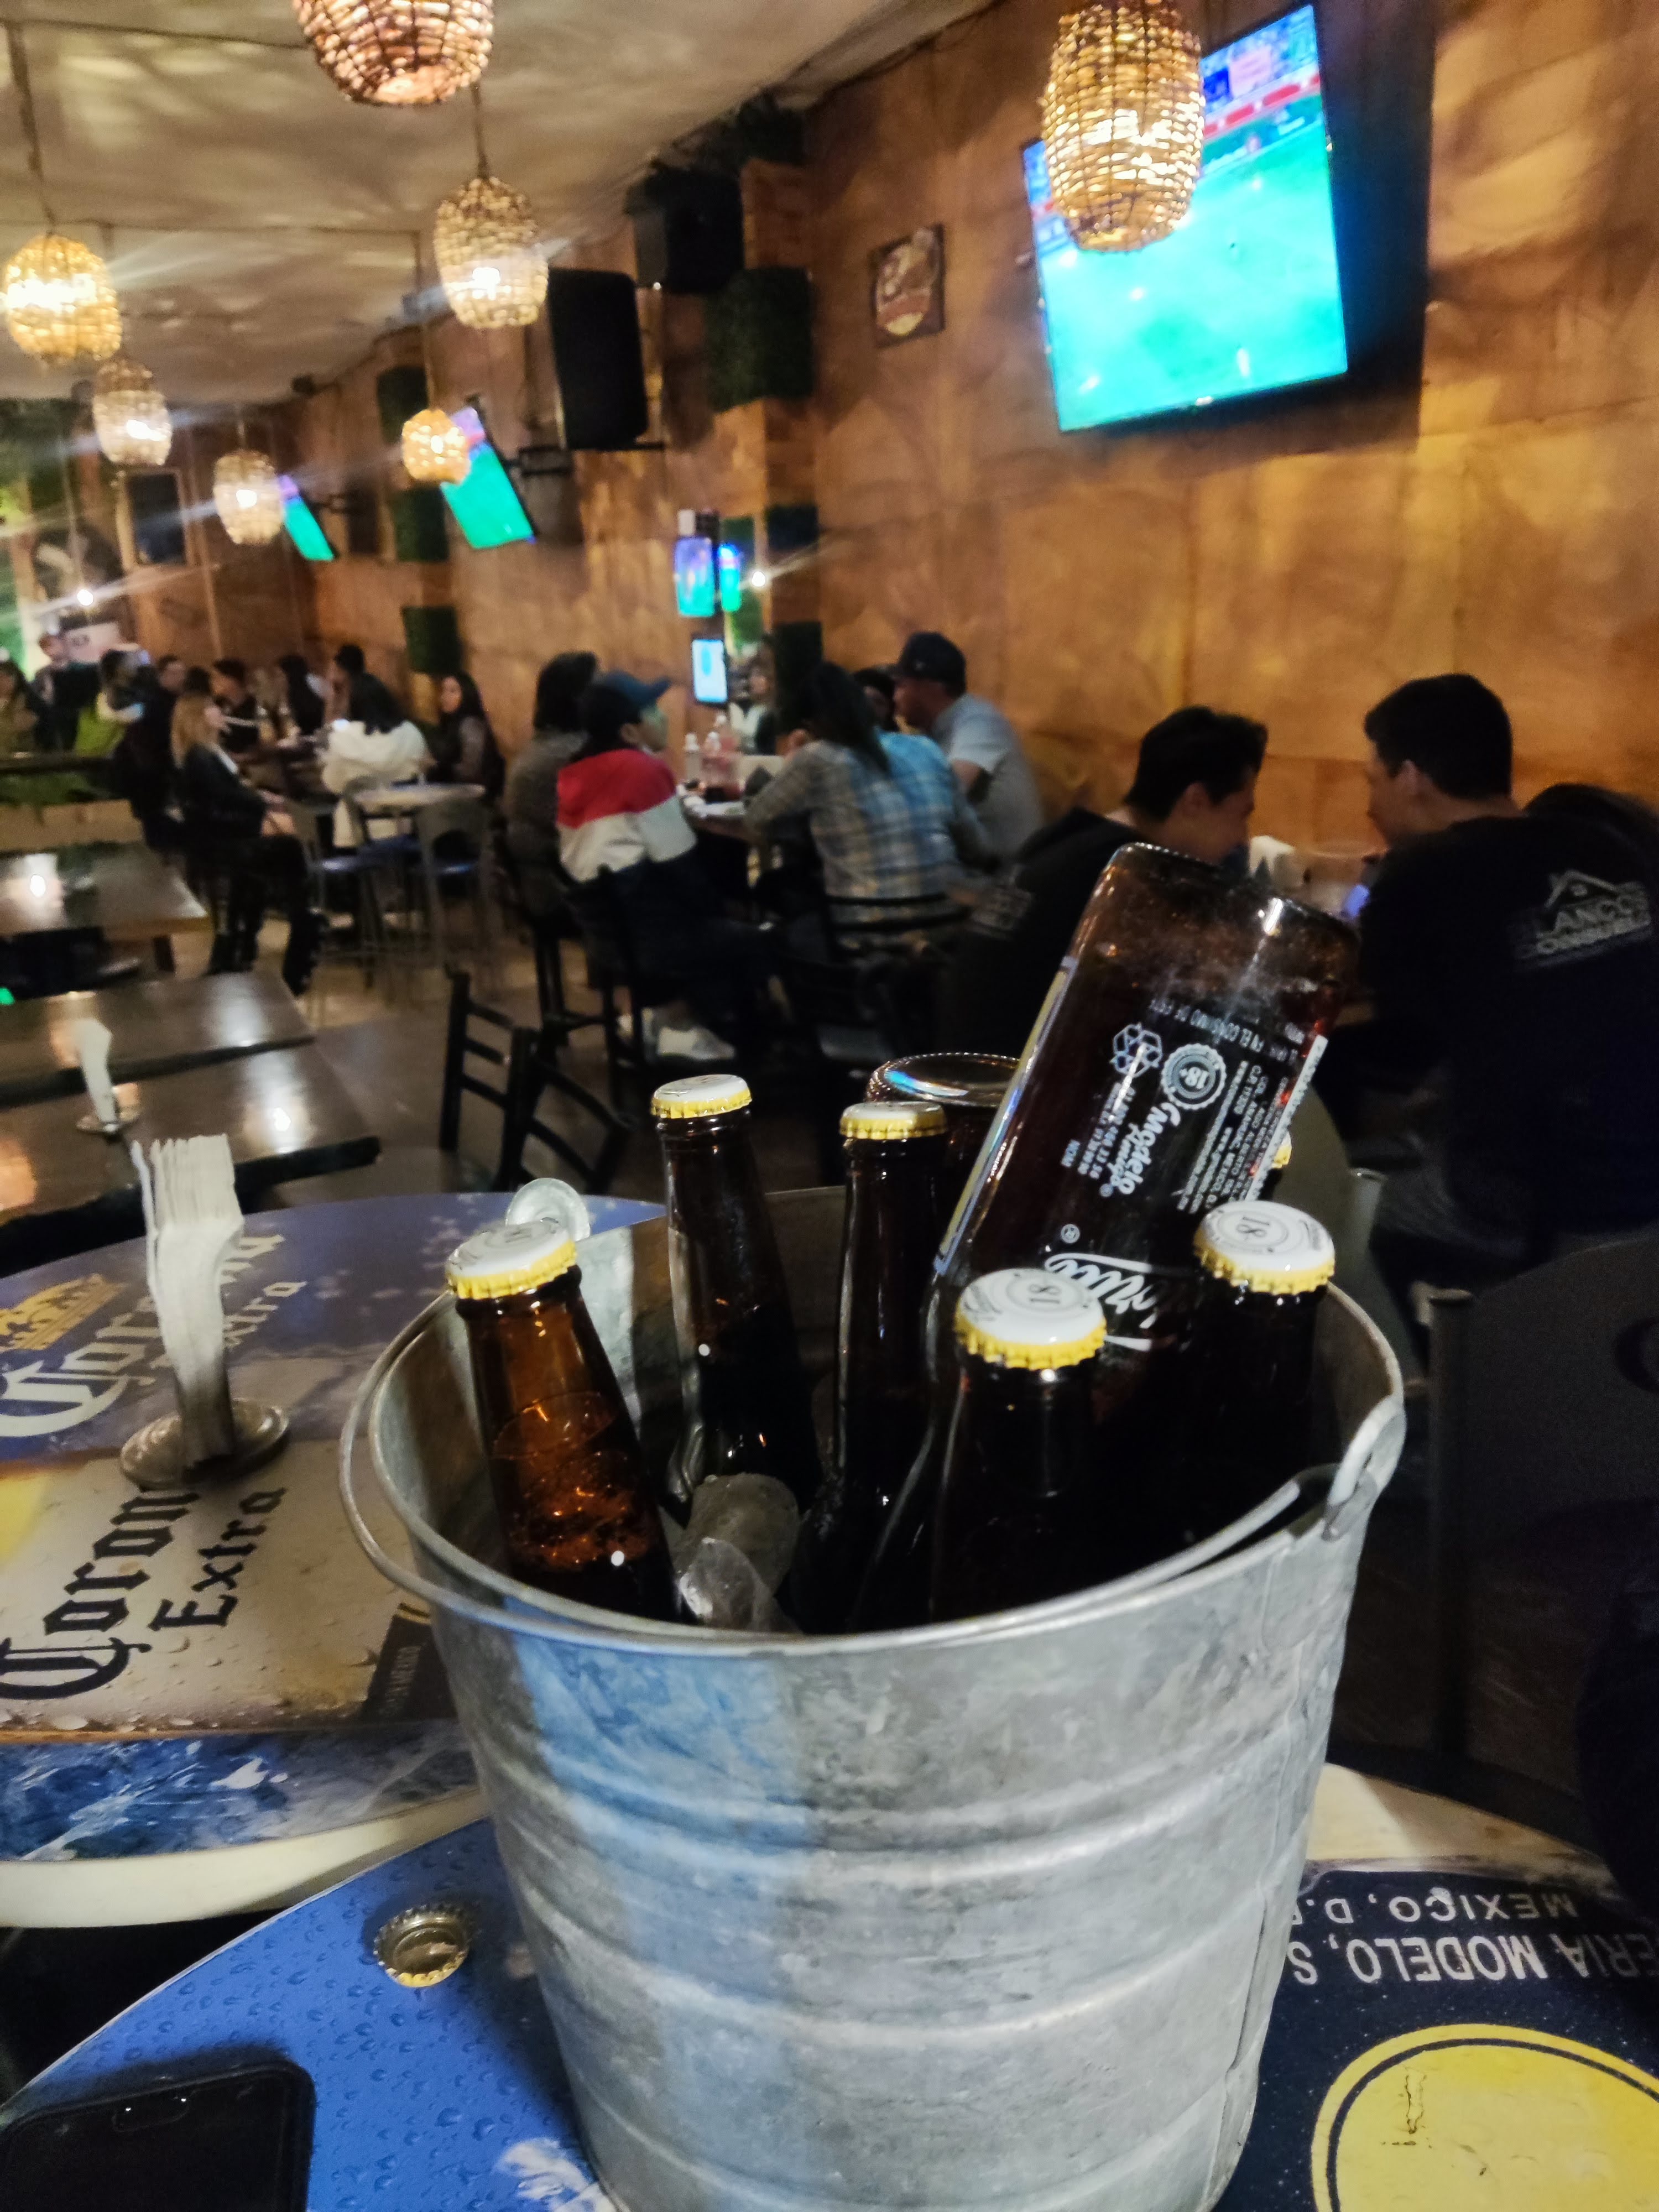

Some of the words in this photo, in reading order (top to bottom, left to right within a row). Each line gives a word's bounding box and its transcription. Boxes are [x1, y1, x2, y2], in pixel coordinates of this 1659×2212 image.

[1119, 1105, 1168, 1194] Modelo
[0, 1234, 285, 1437] Cora
[0, 1485, 200, 1700] Coron
[147, 1486, 287, 1631] Extra
[1368, 1892, 1578, 1922] MEXICO,
[1329, 1934, 1548, 1984] MODELO,
[1549, 1933, 1659, 1979] ERIA
